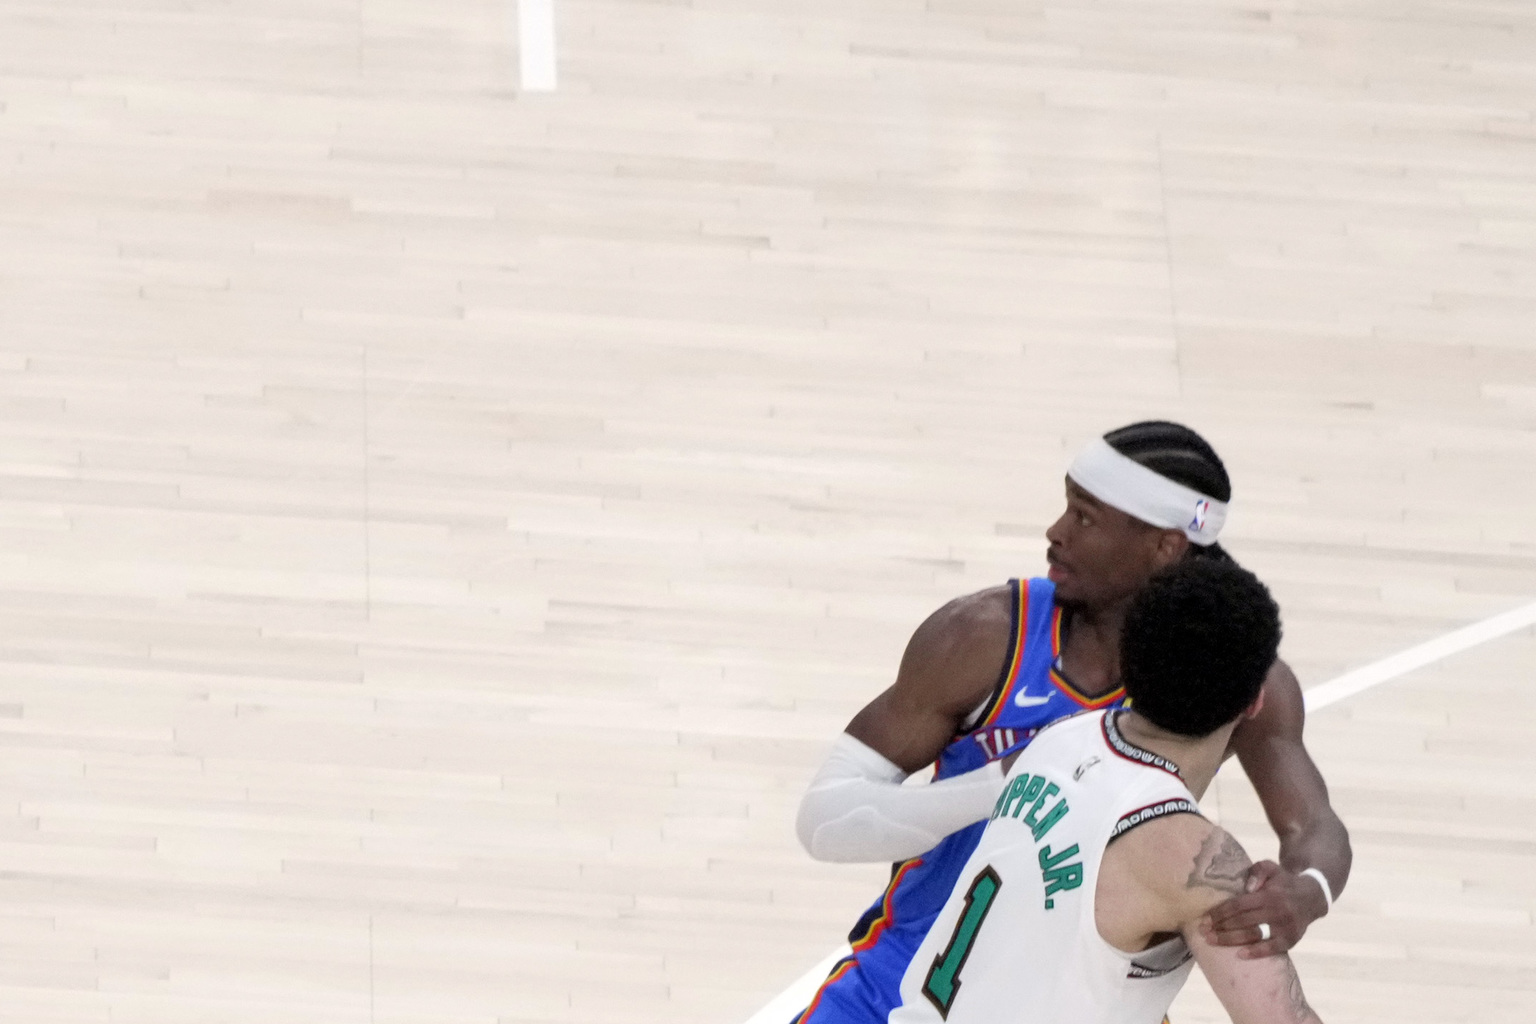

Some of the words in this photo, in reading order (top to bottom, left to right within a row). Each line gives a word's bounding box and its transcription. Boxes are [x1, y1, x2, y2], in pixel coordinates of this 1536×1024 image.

[988, 772, 1070, 843] IPPEN
[1038, 842, 1084, 911] JR.
[921, 863, 1003, 1022] 1
